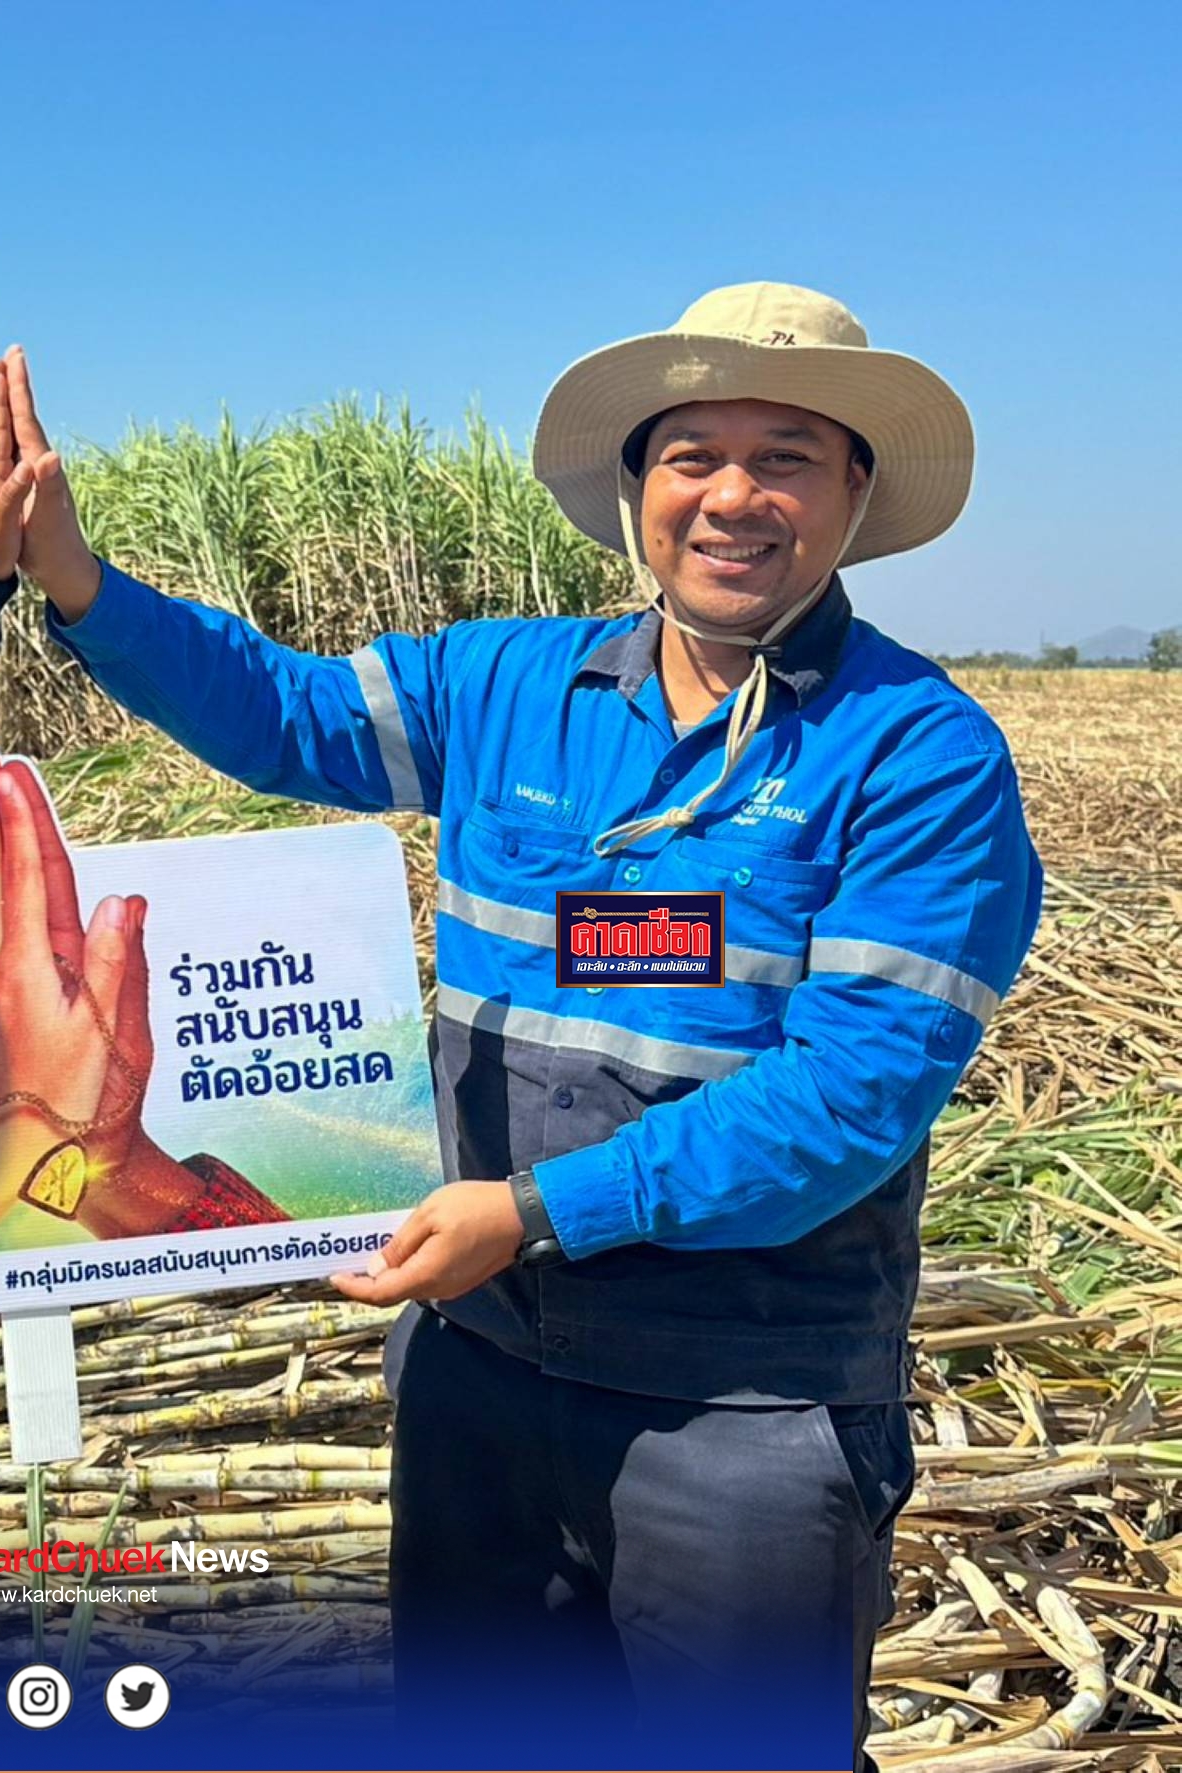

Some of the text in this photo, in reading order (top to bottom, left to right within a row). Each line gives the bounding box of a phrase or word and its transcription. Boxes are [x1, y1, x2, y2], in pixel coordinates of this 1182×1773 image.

[770, 804, 808, 824] PHOL
[169, 940, 315, 997] ร่วมกัน
[175, 995, 364, 1050] สนับสนุน
[180, 1047, 395, 1104] ตัดอ้อยสด
